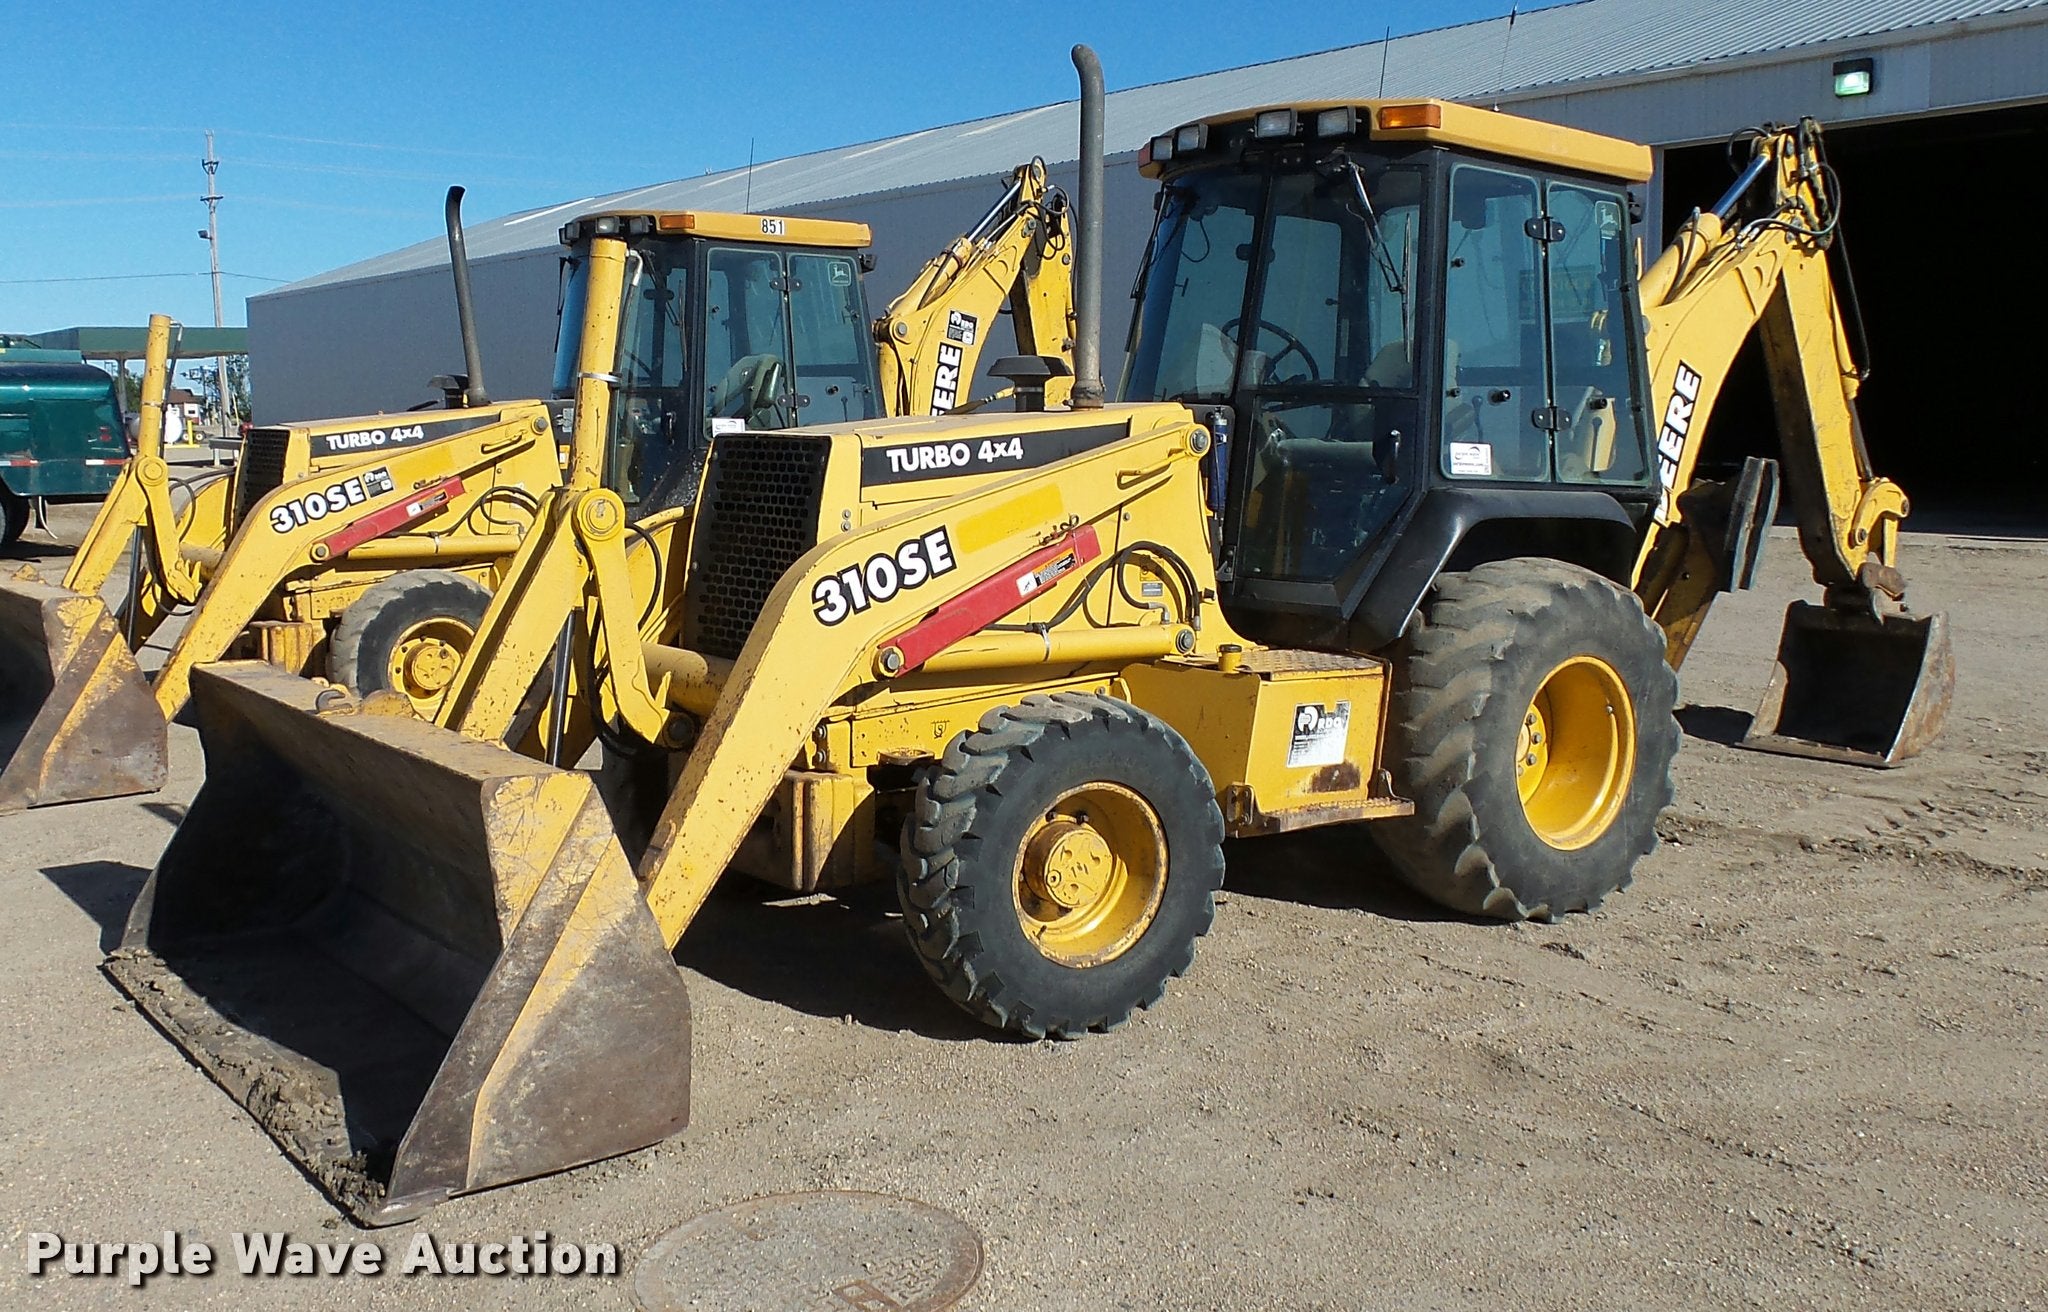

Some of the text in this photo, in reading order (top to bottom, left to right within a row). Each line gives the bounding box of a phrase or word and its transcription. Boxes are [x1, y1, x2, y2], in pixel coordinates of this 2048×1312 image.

[761, 218, 783, 235] 851
[931, 342, 962, 416] ERE
[325, 425, 424, 450] TURBO 4x4
[886, 437, 1024, 473] TURBO 4x4
[269, 476, 366, 534] 310SE
[813, 525, 957, 627] 310SE
